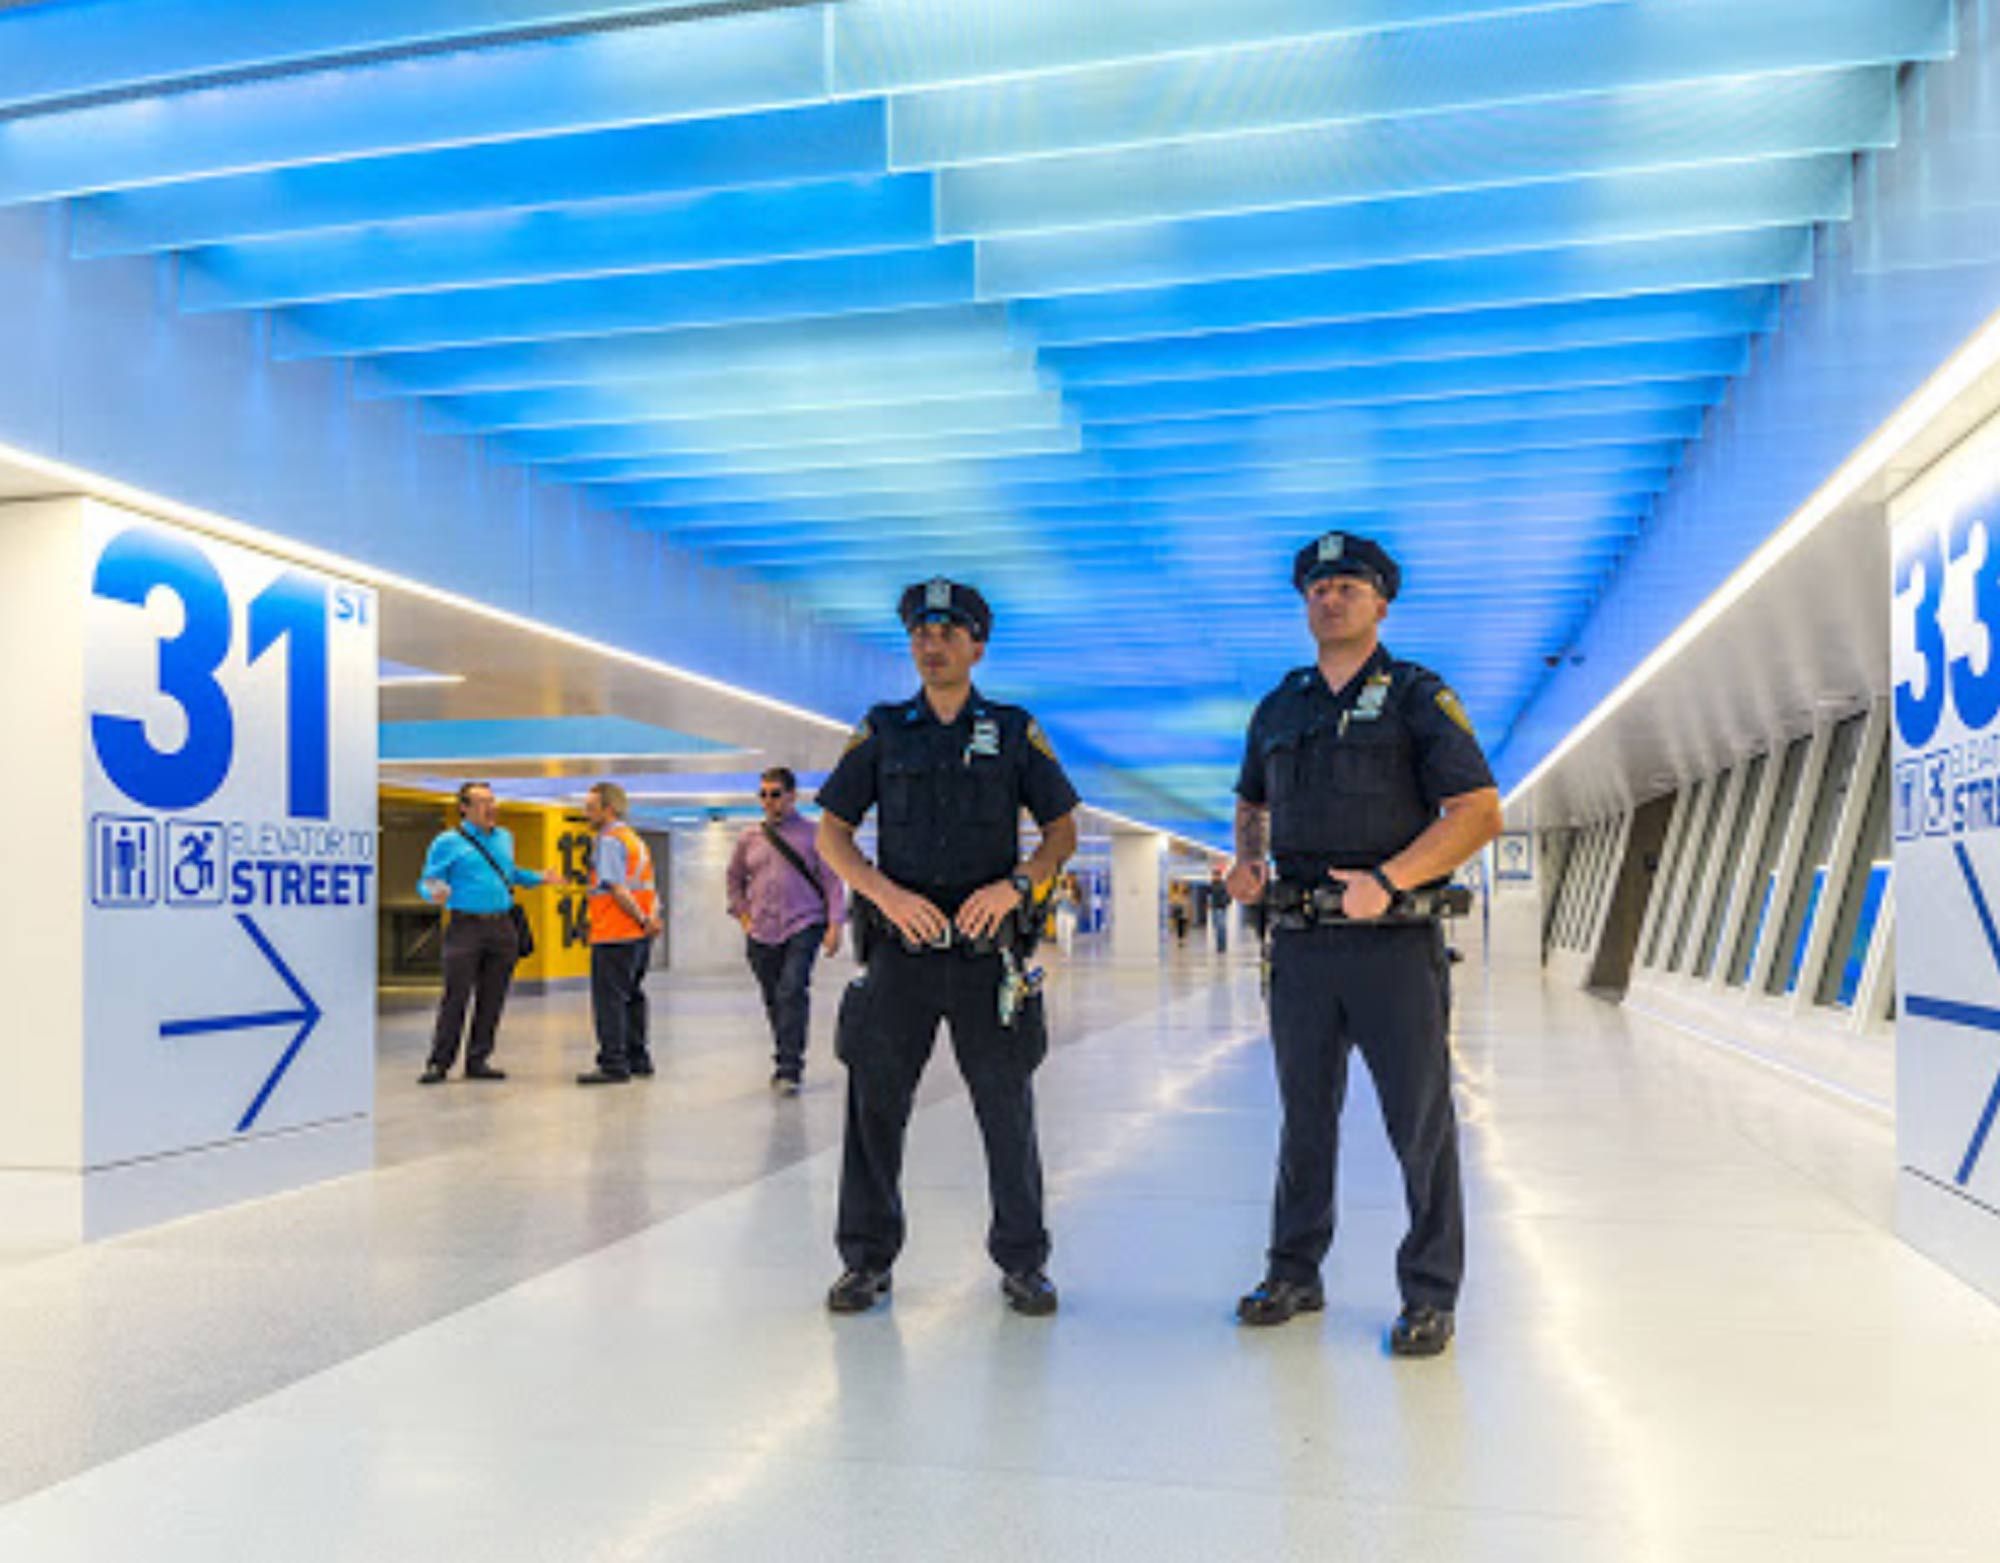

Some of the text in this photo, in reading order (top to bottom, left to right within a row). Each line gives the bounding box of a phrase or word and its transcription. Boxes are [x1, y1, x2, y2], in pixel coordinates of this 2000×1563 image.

[1895, 492, 2000, 748] 33
[92, 525, 330, 820] 31
[1953, 776, 2000, 832] STR
[231, 821, 344, 856] ELEVATOR
[231, 860, 374, 906] STREET
